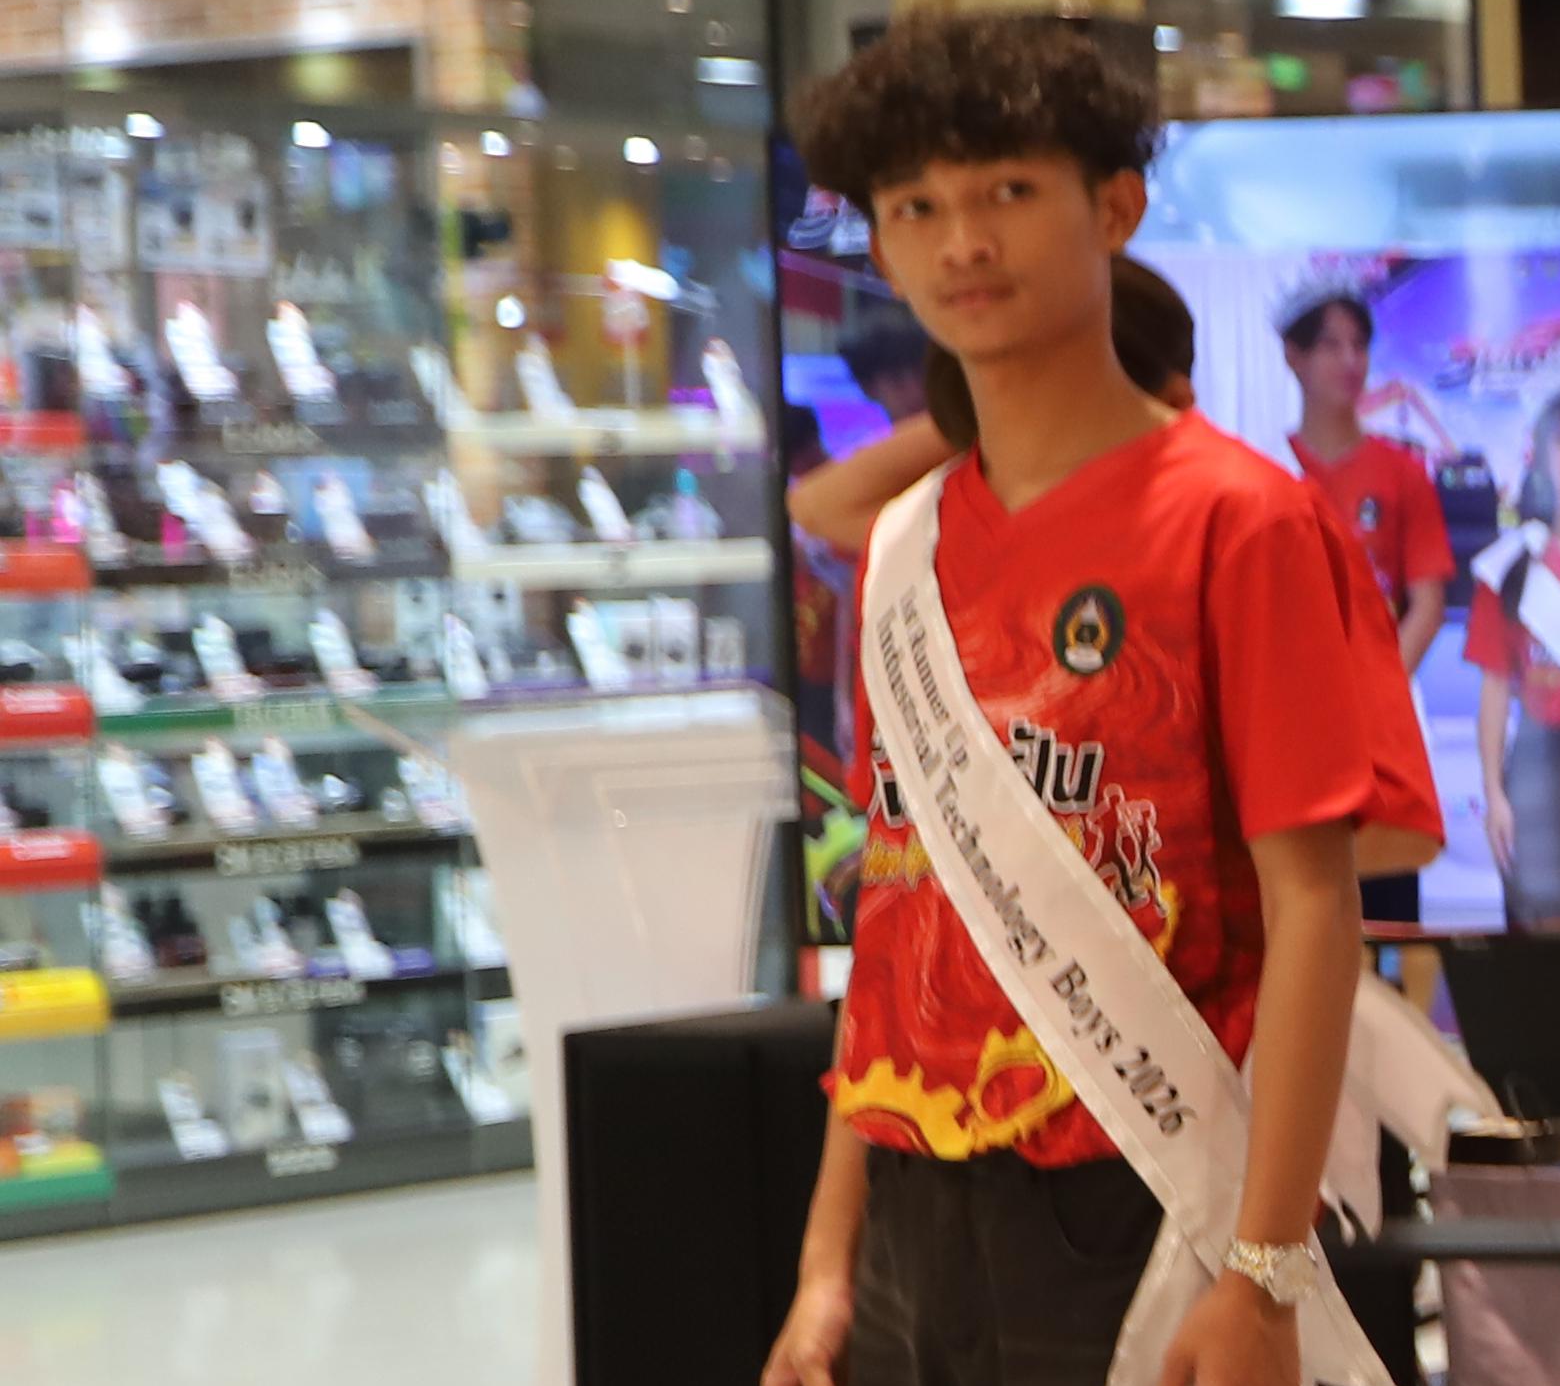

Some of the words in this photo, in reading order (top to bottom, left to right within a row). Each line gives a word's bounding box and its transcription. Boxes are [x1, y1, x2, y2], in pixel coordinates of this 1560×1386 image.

[934, 766, 1057, 966] Technology
[1051, 953, 1121, 1056] Boys
[1112, 1046, 1199, 1136] 2026
